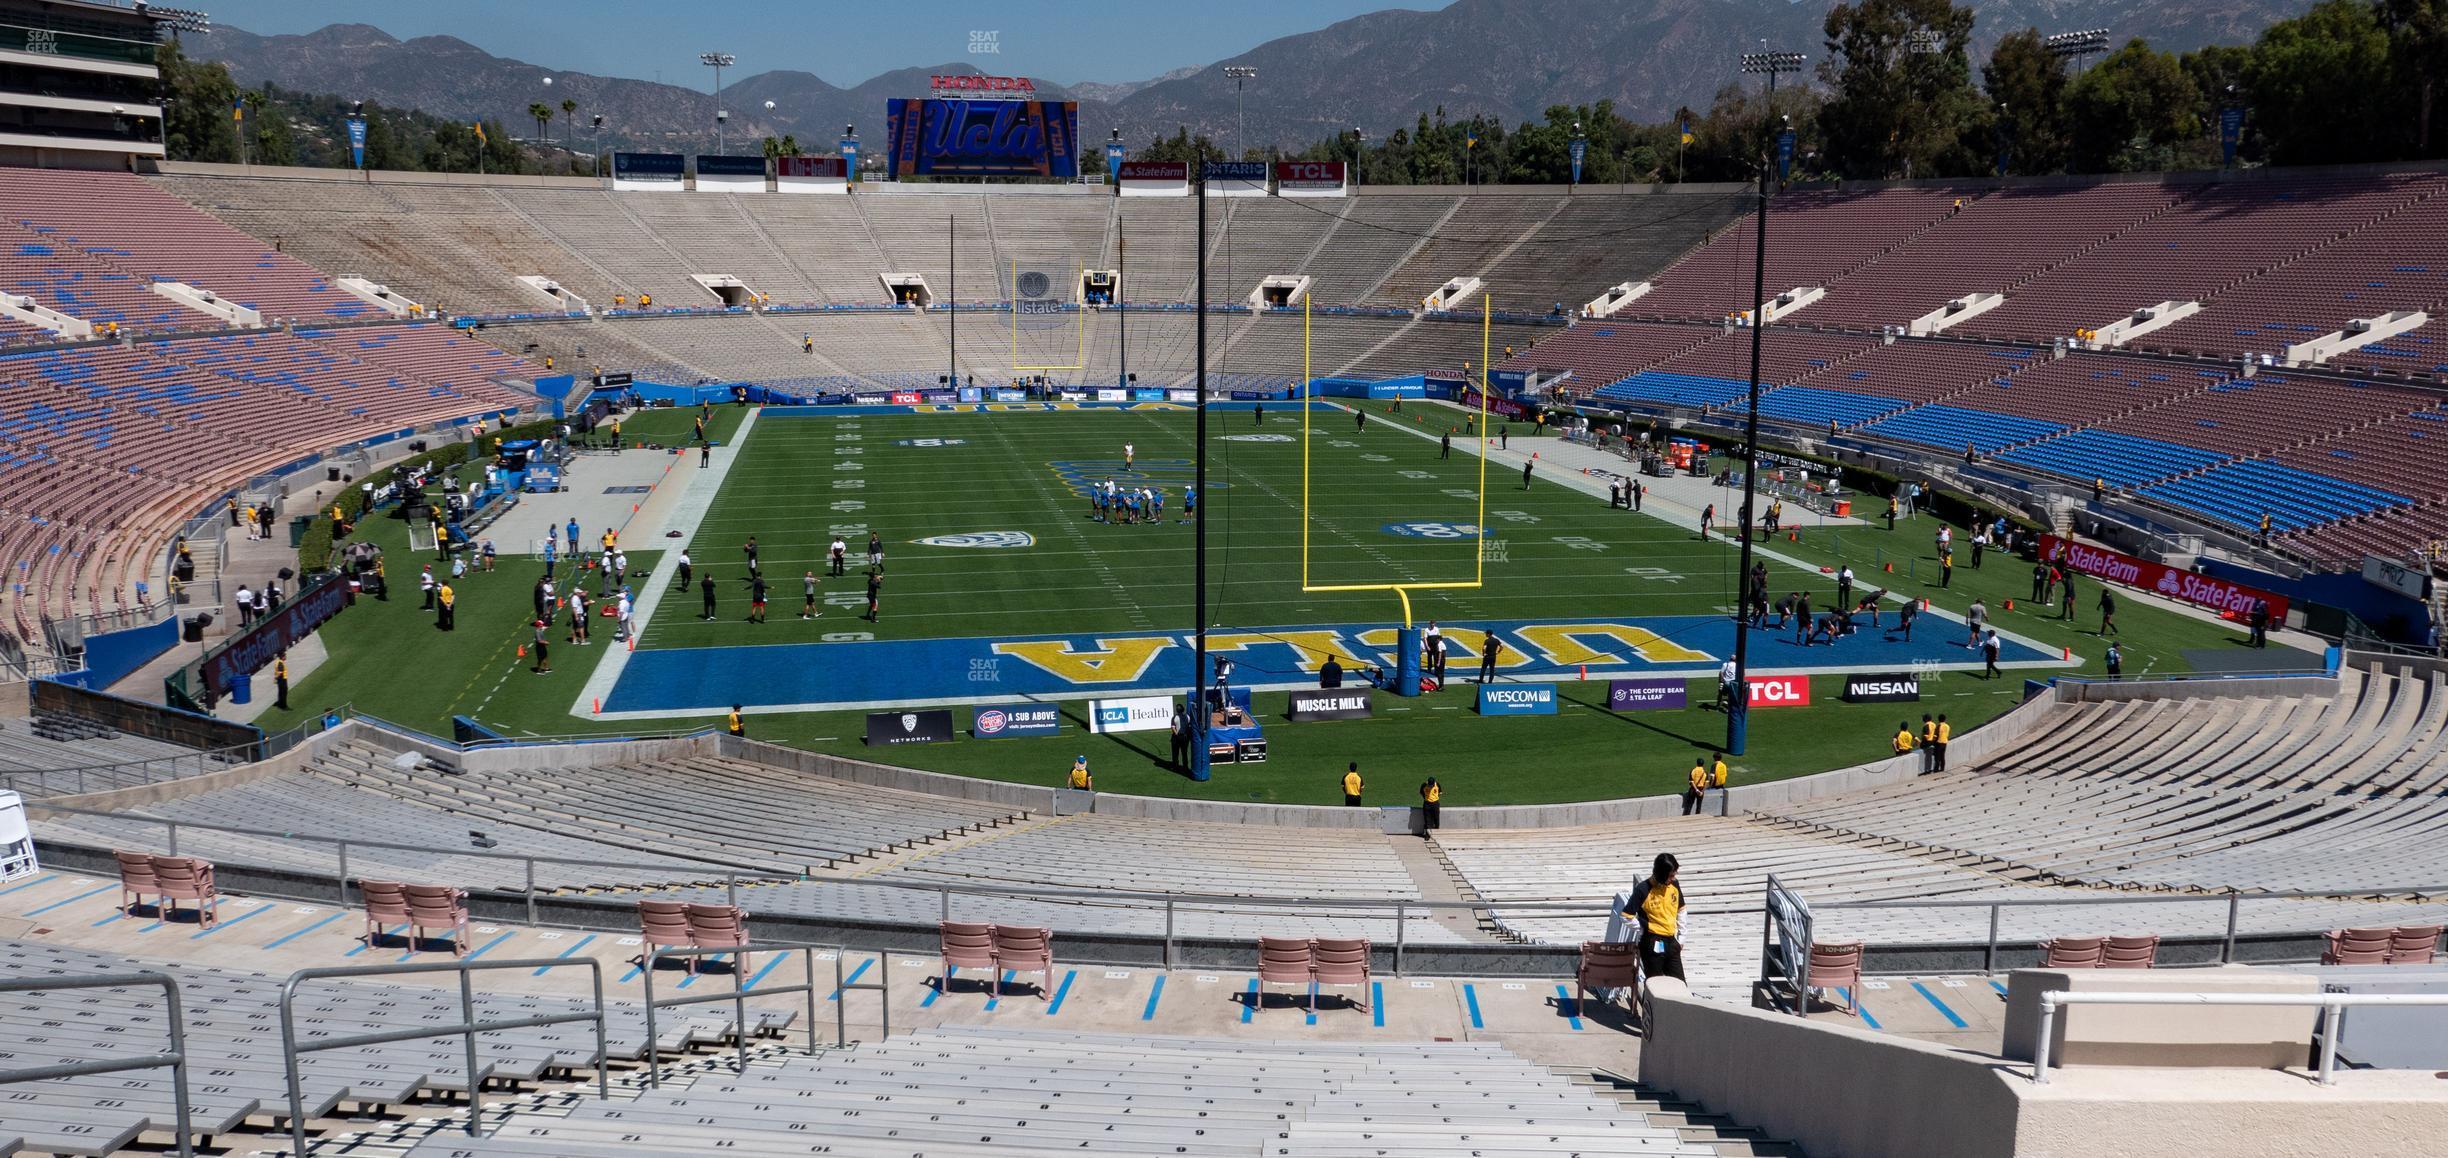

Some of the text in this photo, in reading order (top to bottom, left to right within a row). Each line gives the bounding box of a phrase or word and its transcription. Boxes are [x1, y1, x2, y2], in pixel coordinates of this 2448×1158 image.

[930, 76, 1036, 92] HONDA
[1290, 164, 1333, 179] TCL
[1426, 370, 1465, 378] HONDA
[991, 623, 1720, 684] UCLA
[1749, 682, 1800, 700] TCL
[1851, 682, 1918, 695] NISSAN
[1486, 690, 1538, 702] WESCOM
[1296, 697, 1365, 712] MUSCLE MILK
[1008, 713, 1013, 722] A
[1015, 712, 1030, 721] SUB
[1100, 708, 1168, 720] UCLA Health
[62, 1125, 94, 1133] 113
